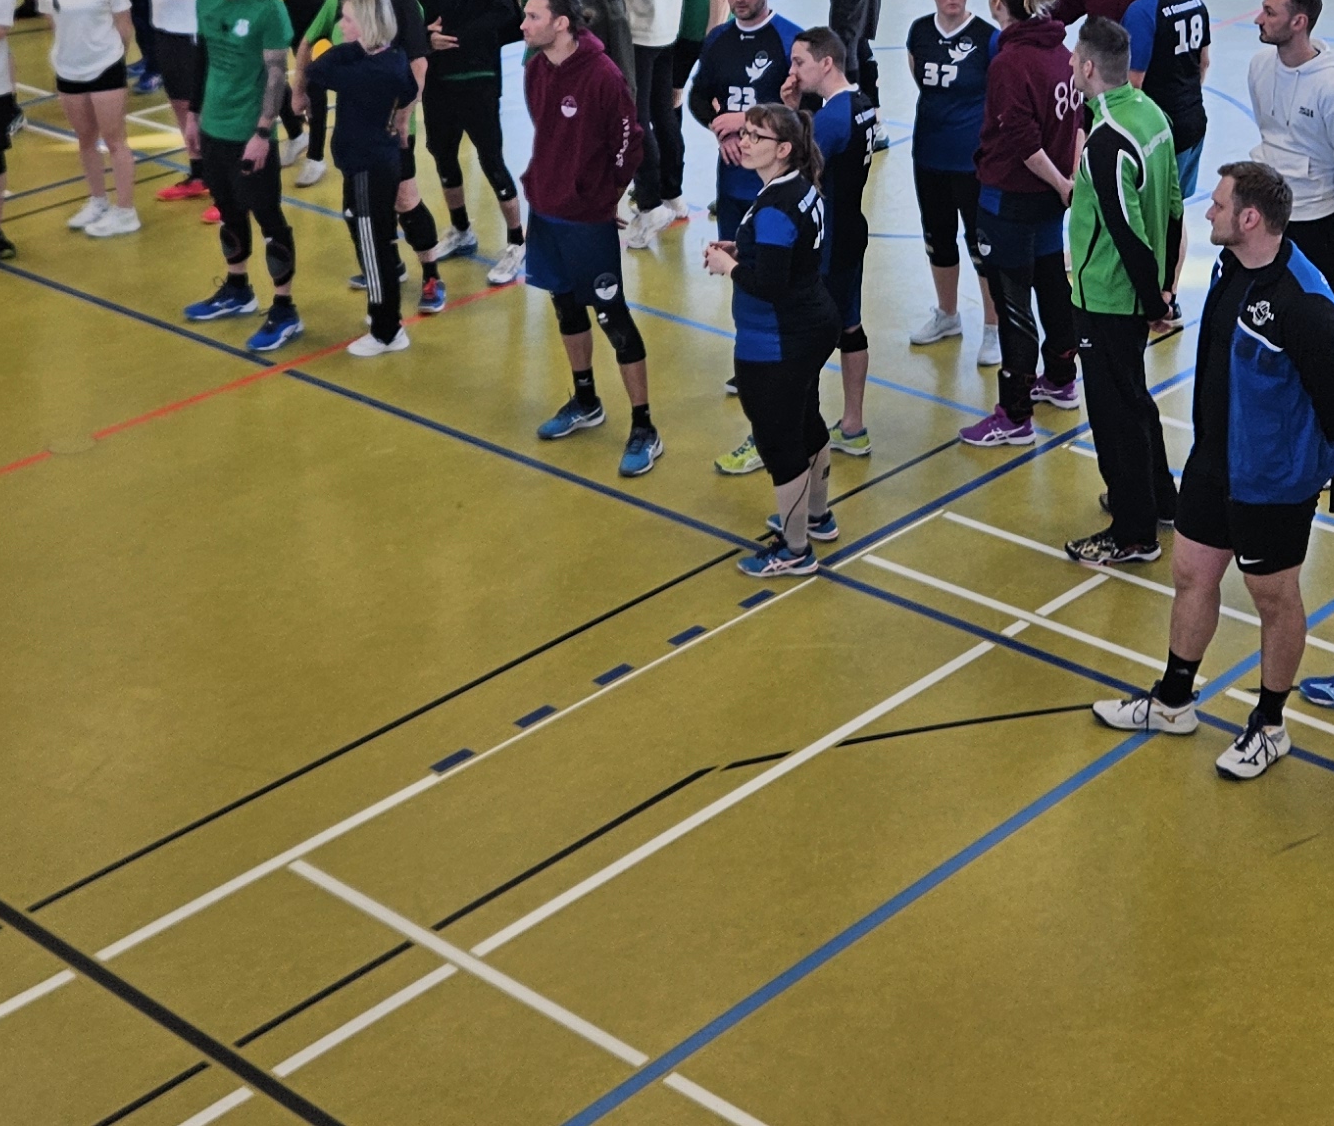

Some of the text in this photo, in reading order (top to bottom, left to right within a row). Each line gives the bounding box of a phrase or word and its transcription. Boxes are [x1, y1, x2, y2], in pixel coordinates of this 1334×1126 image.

[1174, 14, 1203, 55] 18
[922, 62, 958, 88] 37
[727, 85, 757, 112] 23
[1054, 73, 1081, 121] 86
